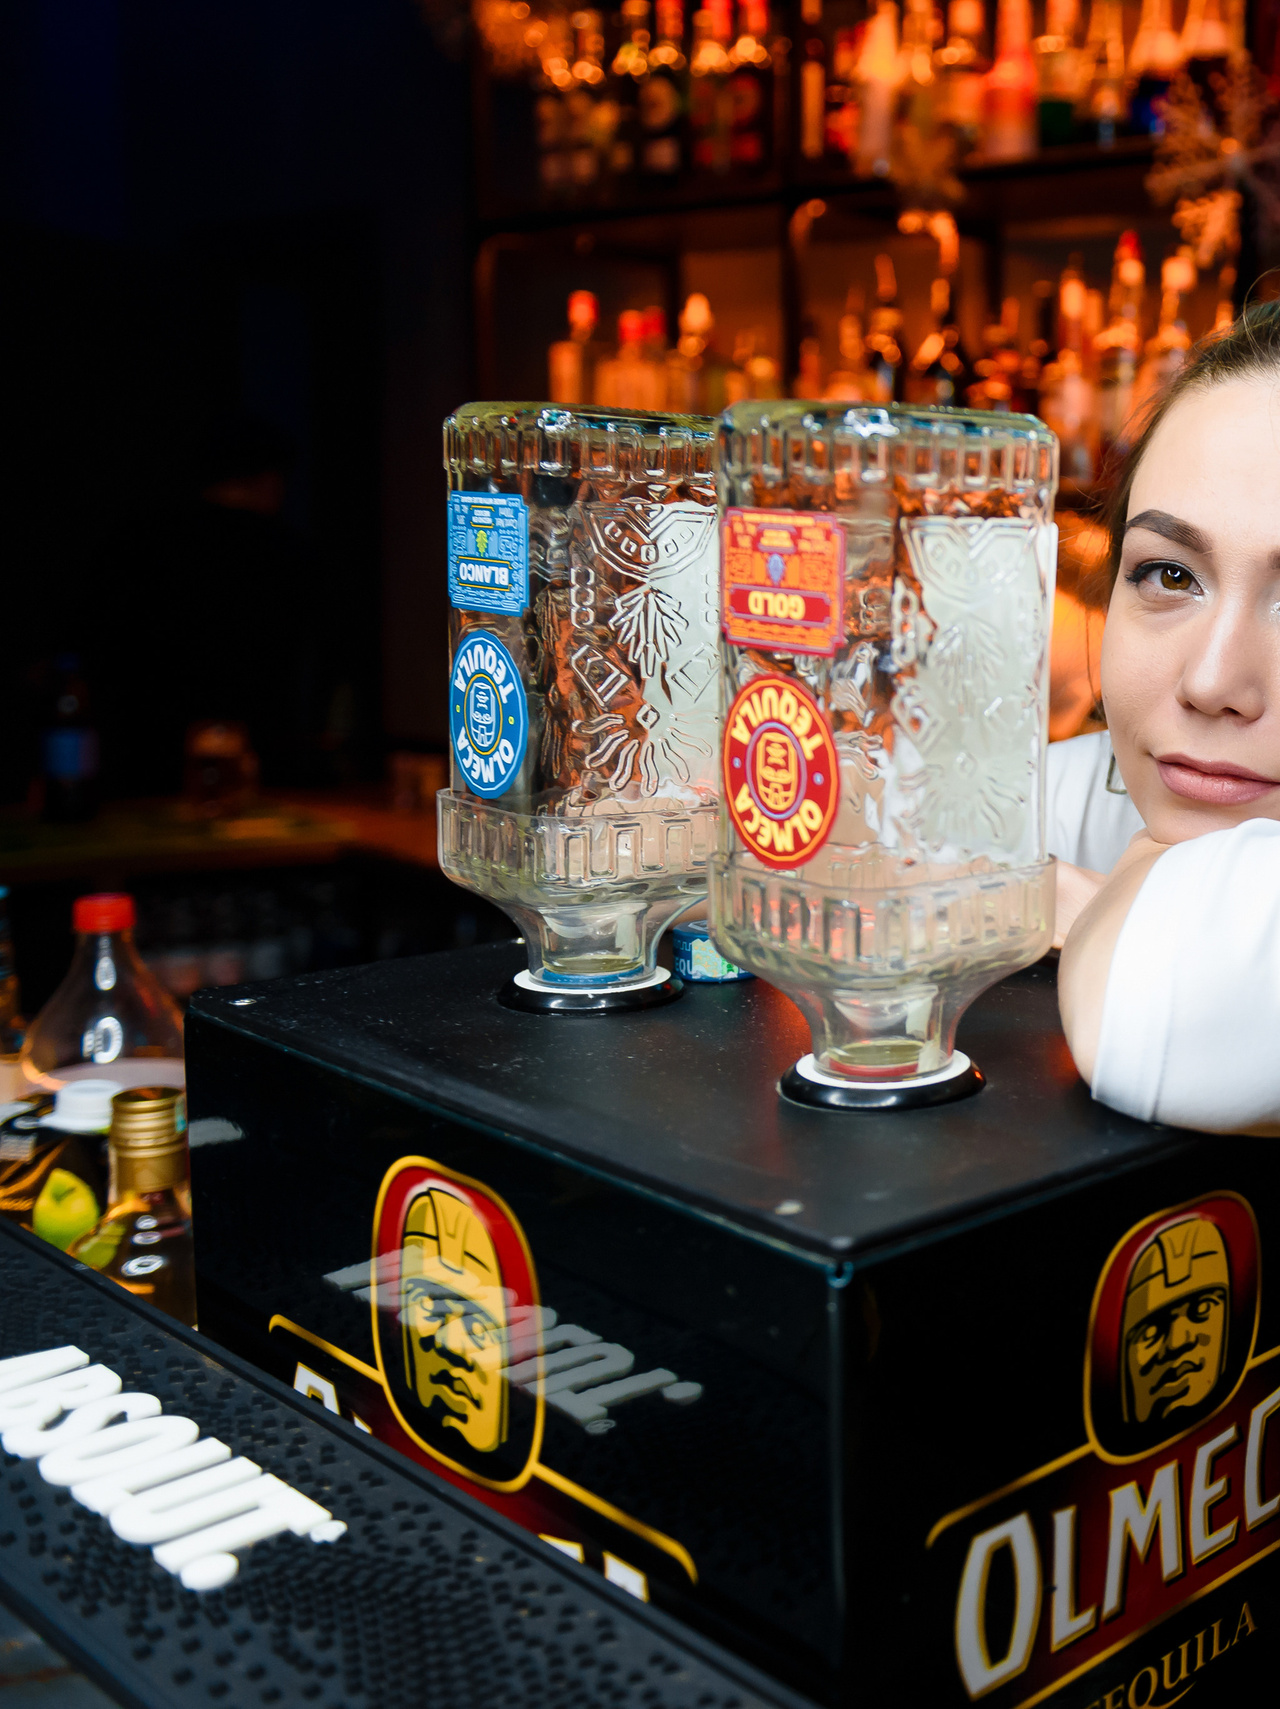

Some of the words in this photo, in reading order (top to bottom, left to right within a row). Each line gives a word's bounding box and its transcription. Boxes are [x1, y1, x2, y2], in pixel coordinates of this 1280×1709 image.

[459, 562, 509, 586] BLANCO
[748, 590, 806, 621] GOLD
[454, 644, 515, 704] TEQUILA
[730, 687, 824, 761] TEQUILA
[456, 726, 515, 783] OLMECA
[734, 782, 824, 852] OLMECA
[1084, 1601, 1258, 1709] EQUILA
